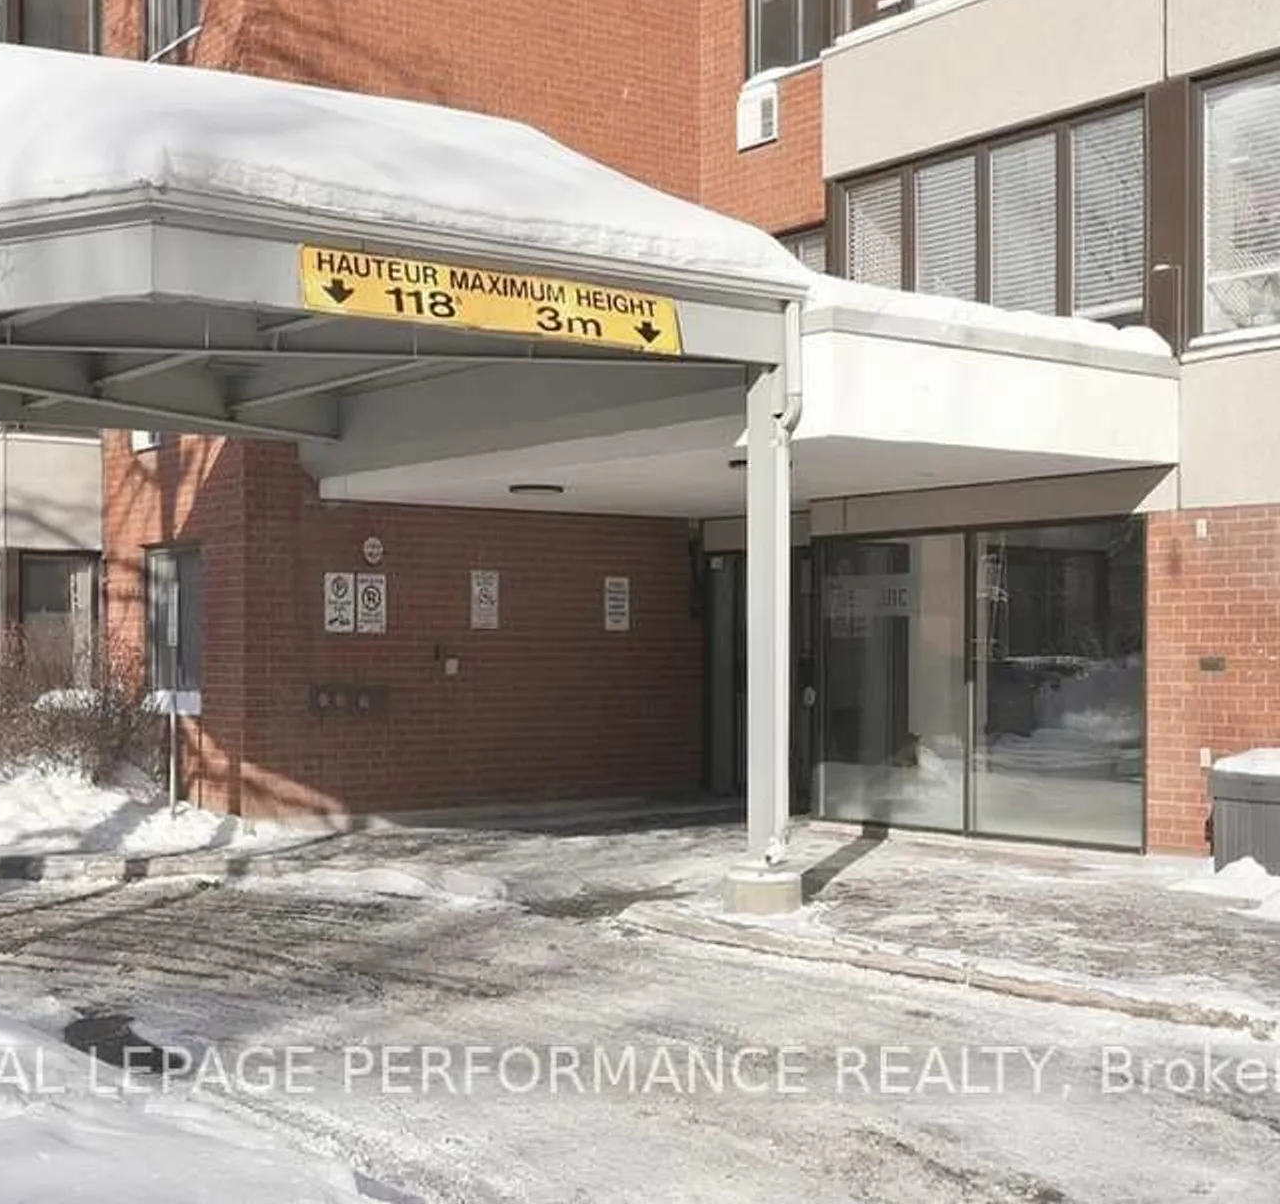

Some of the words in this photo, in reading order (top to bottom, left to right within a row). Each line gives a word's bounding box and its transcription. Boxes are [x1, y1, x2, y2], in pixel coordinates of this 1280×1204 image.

[317, 252, 438, 286] HAUTEUR
[450, 270, 566, 304] MAXIMUM
[575, 288, 657, 317] HEIGHT
[536, 306, 602, 337] 3m
